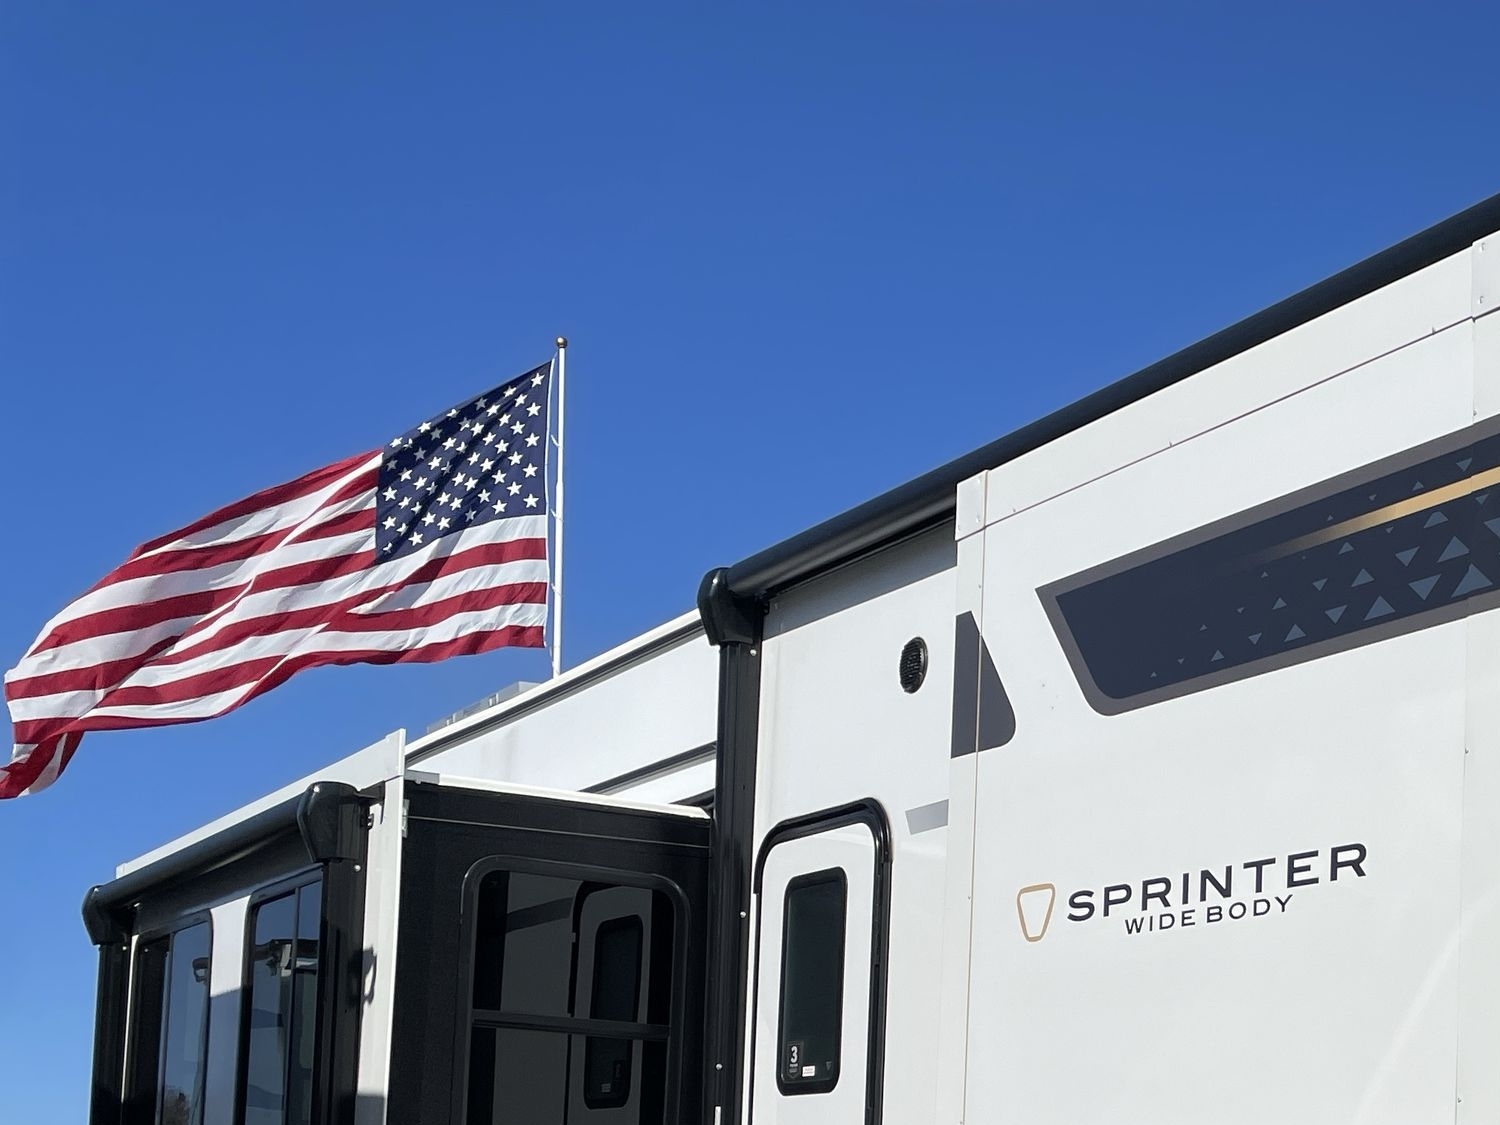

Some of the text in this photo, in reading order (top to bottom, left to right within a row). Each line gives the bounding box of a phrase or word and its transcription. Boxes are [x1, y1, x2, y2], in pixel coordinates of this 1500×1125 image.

[1067, 843, 1368, 922] SPRINTER
[1124, 894, 1294, 935] WIDE BODY
